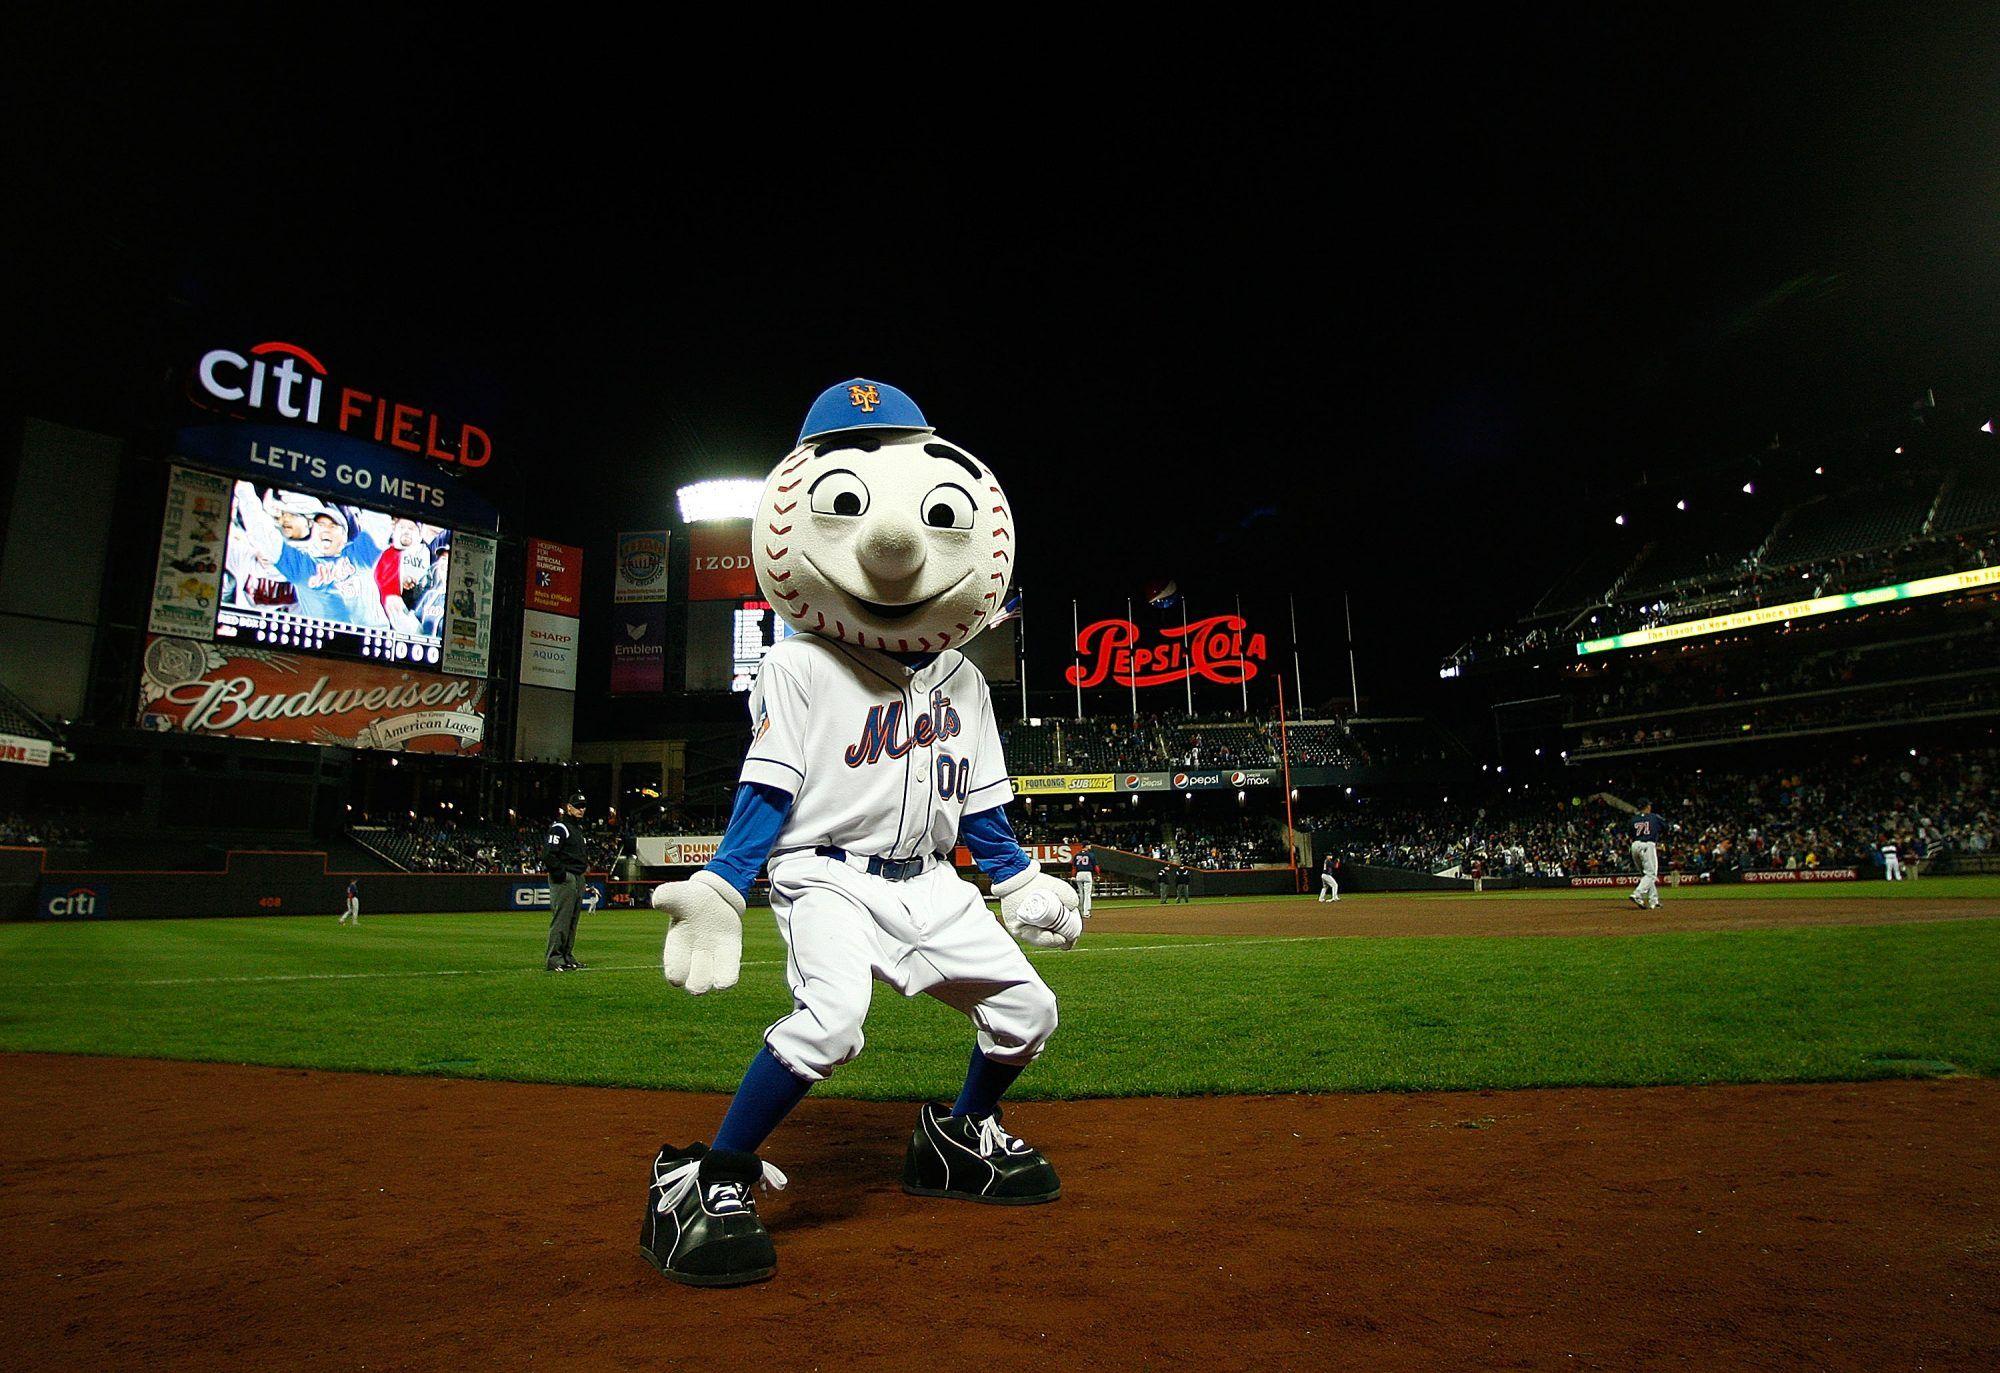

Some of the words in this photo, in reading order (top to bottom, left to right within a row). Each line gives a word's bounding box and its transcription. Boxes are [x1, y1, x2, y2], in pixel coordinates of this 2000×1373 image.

[200, 342, 326, 424] citi
[339, 387, 492, 468] FIELD
[848, 384, 880, 413] NY
[250, 442, 327, 478] LET'S
[335, 464, 372, 488] GO
[380, 475, 445, 507] METS
[536, 555, 562, 566] SPECIAL
[536, 562, 566, 573] SURGERY
[696, 555, 750, 570] IZOD
[477, 558, 494, 650] SALES
[1648, 631, 1664, 640] The
[1666, 628, 1693, 638] Flavor
[1755, 610, 1785, 621] Since
[530, 630, 572, 643] SHARP
[532, 650, 566, 661] AQUOS
[615, 643, 663, 655] Emblem
[165, 675, 469, 732] Budweiser
[384, 720, 442, 740] American
[445, 718, 479, 734] Lager
[845, 689, 961, 768] Mets
[936, 753, 970, 804] 00
[1025, 778, 1065, 788] FOOTLONGS
[1069, 777, 1112, 790] SUBWAY
[1189, 775, 1219, 786] pepsi
[1246, 777, 1270, 785] max
[1634, 821, 1650, 836] 71
[1760, 872, 1796, 880] TOYOTA
[1815, 870, 1855, 879] TOYOTA
[49, 889, 95, 915] citi
[515, 888, 551, 905] GE
